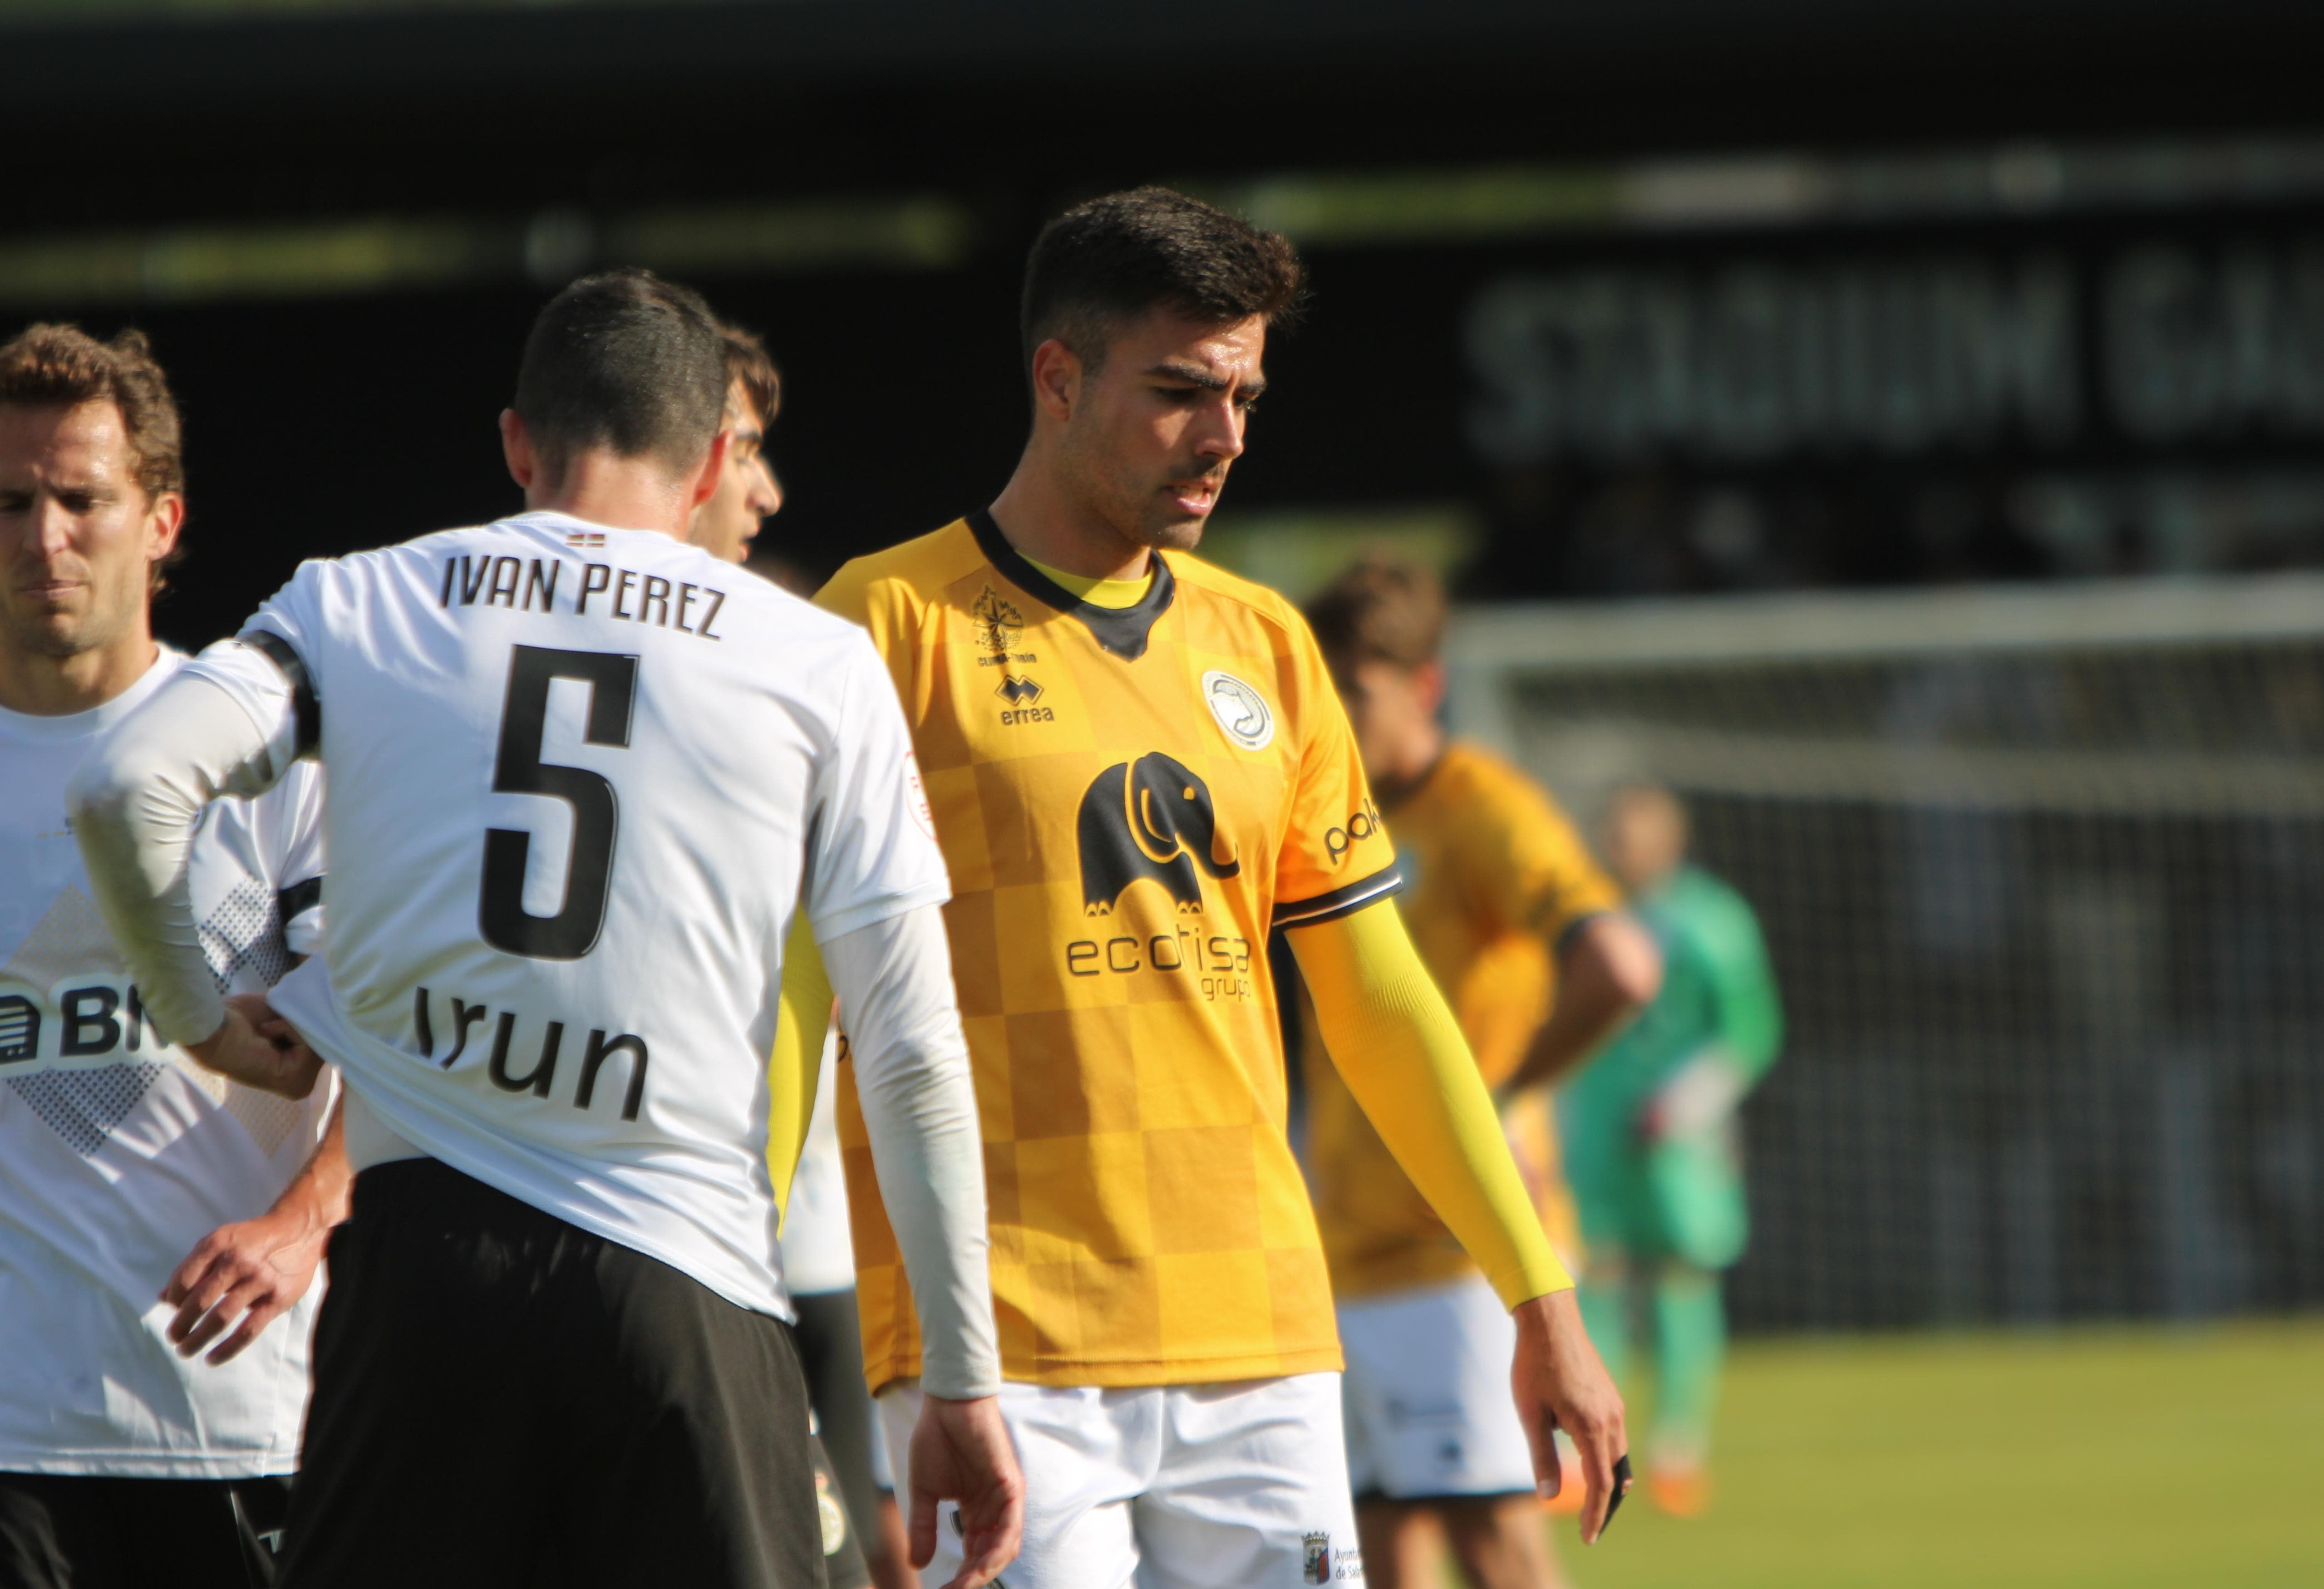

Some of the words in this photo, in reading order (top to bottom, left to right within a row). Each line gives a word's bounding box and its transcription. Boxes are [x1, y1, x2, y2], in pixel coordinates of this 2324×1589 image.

[438, 555, 560, 615] IVAN
[574, 562, 726, 641] PEREZ
[478, 643, 641, 962] 5
[1201, 978, 1251, 1002] grupo
[414, 986, 648, 1122] Irun
[1336, 1566, 1346, 1580] de
